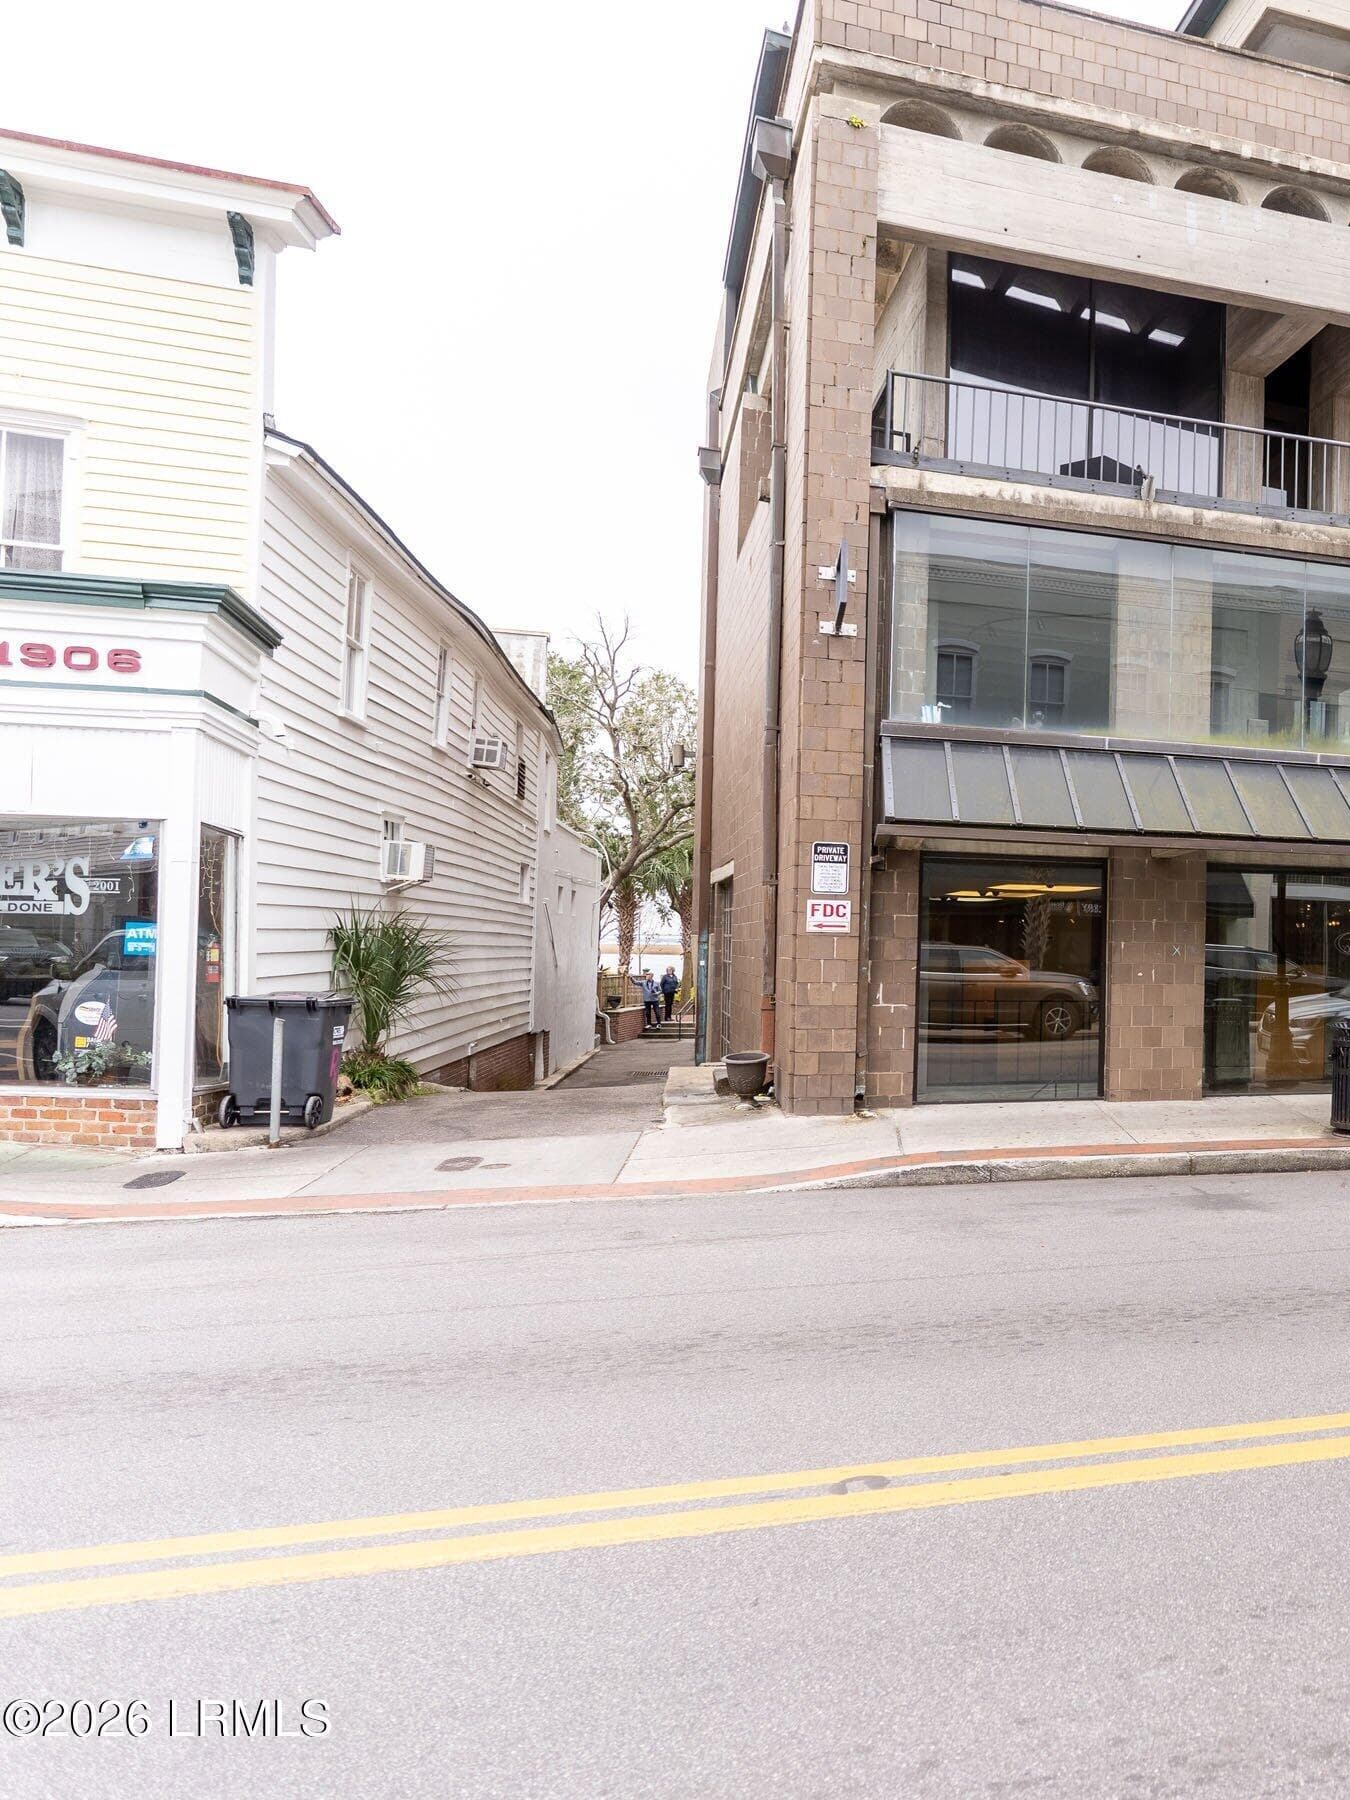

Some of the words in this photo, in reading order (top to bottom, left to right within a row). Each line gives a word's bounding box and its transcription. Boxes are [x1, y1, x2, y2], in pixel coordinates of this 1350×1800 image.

[0, 641, 142, 673] 1906
[814, 854, 848, 862] DRIVEWAY
[93, 881, 120, 891] 2001
[7, 902, 53, 912] DONE
[811, 904, 847, 917] FDC
[126, 928, 157, 939] ATM
